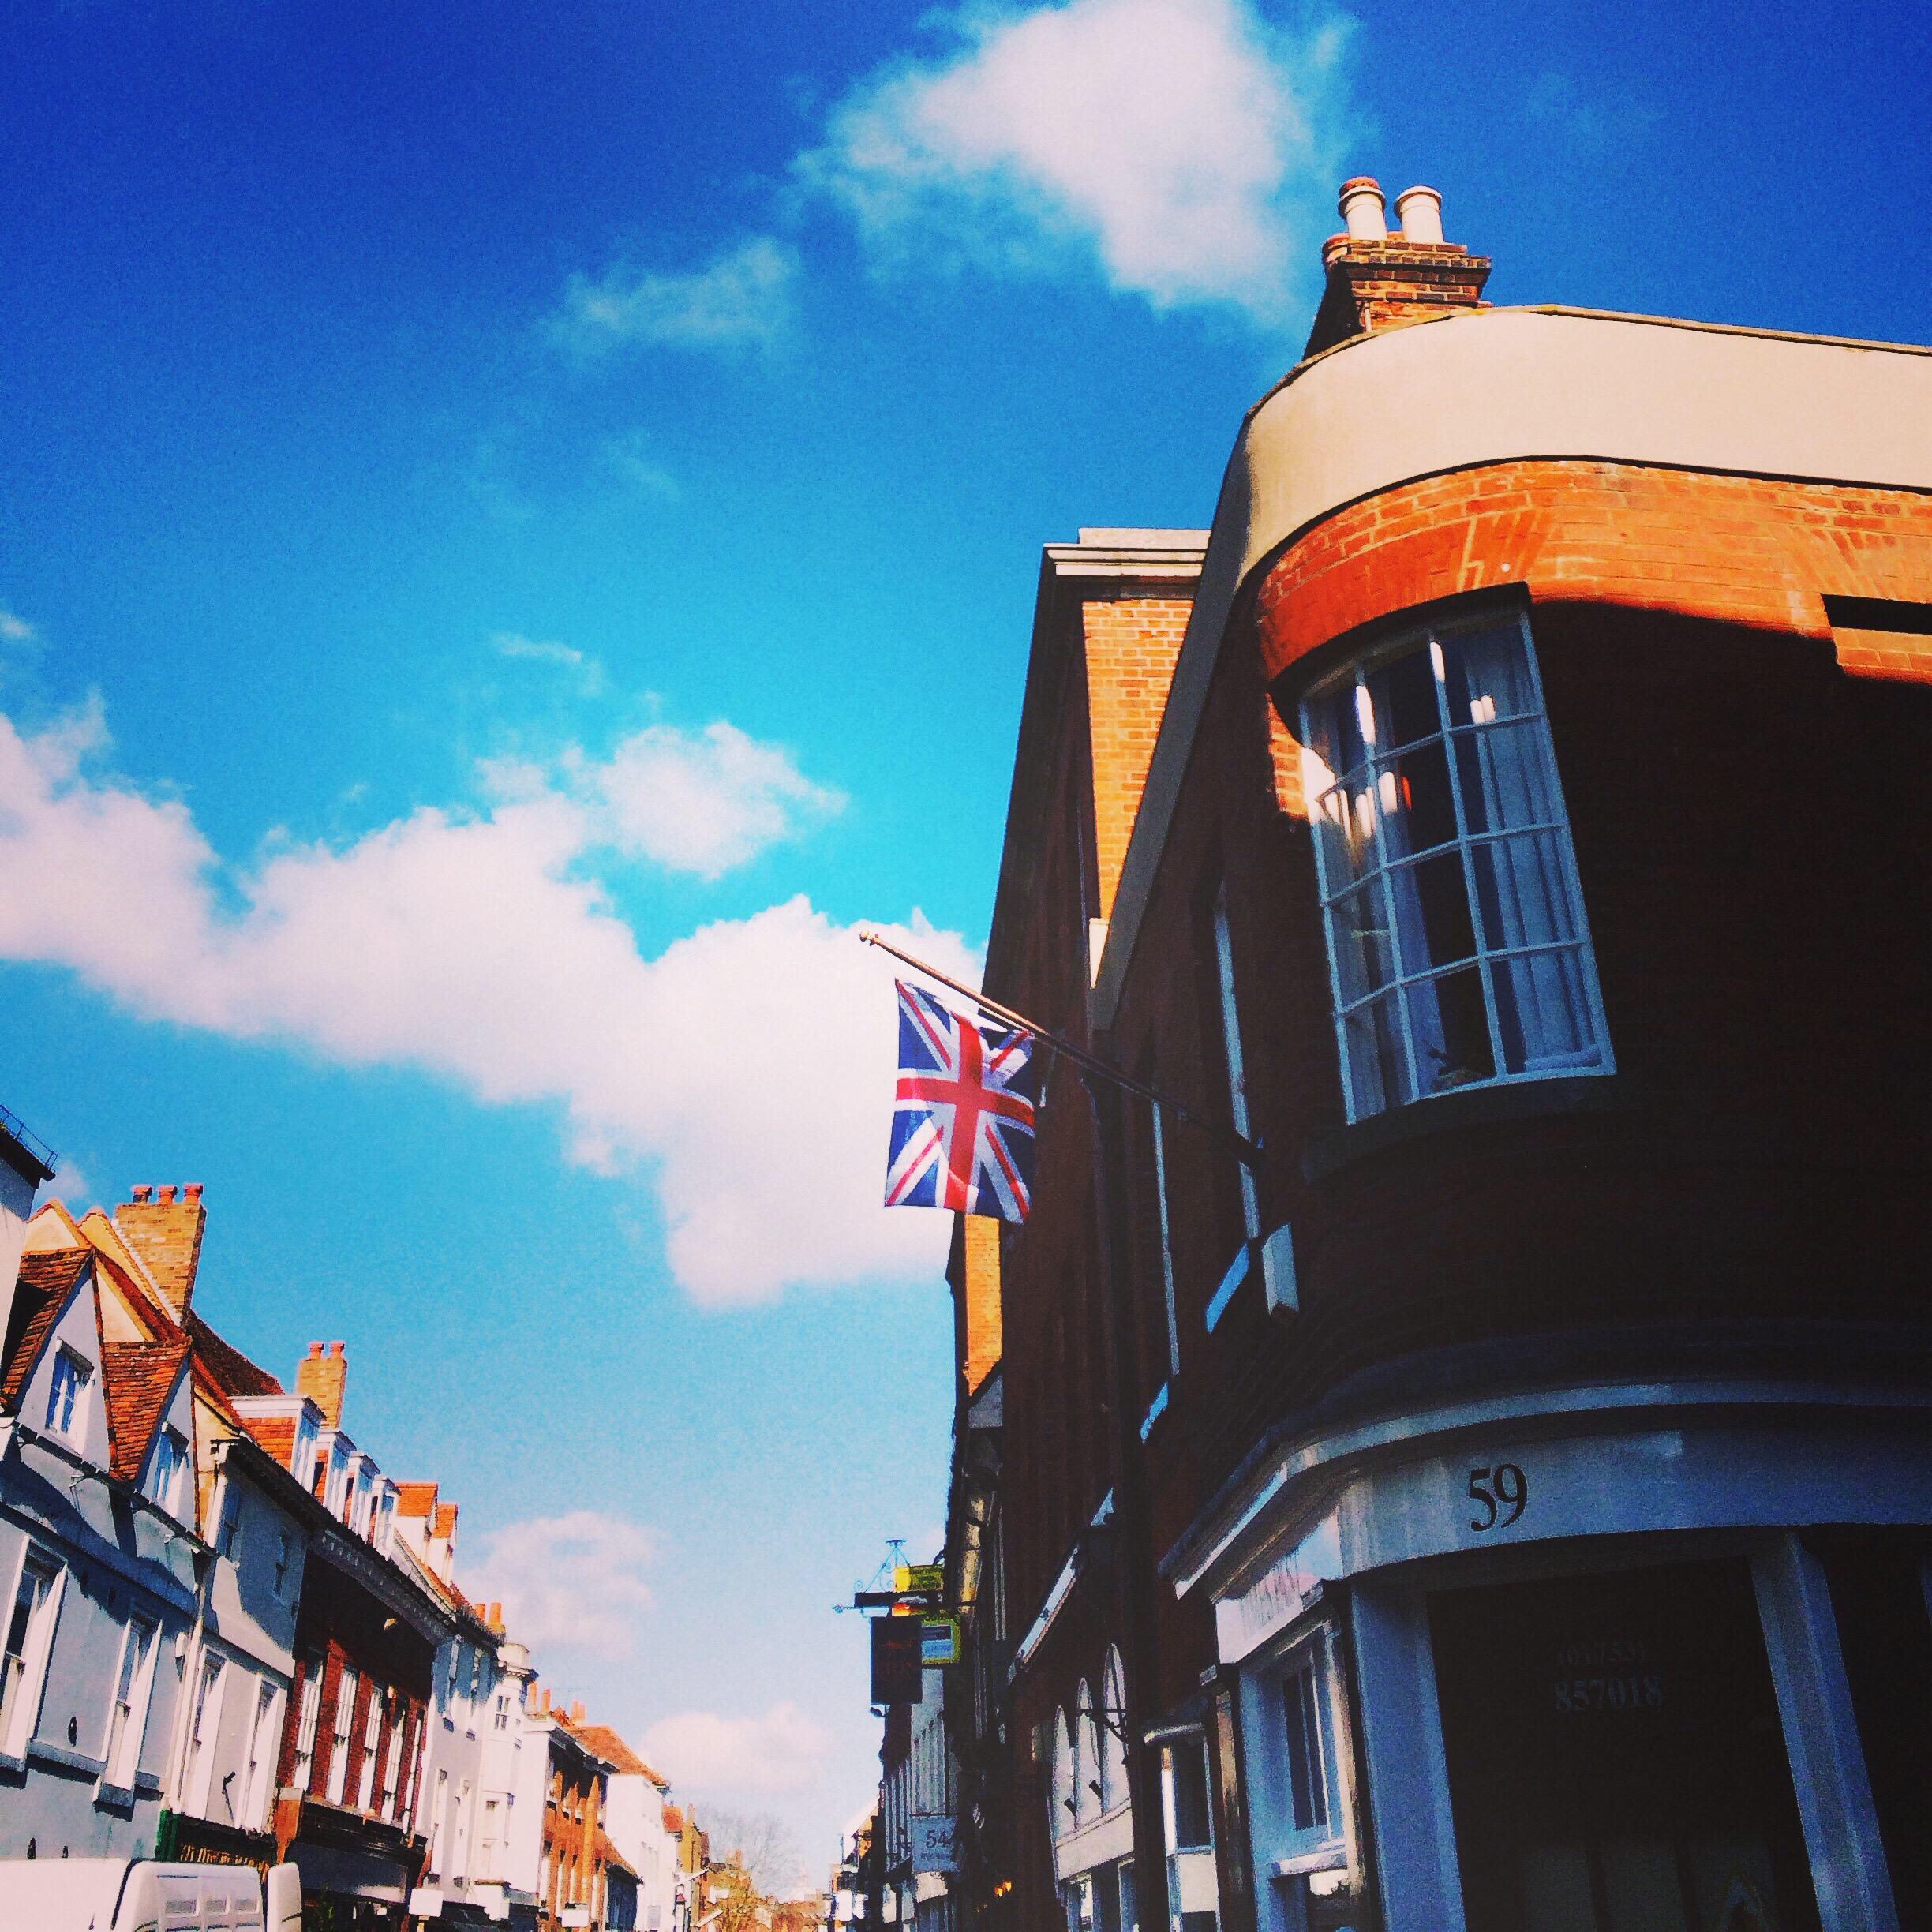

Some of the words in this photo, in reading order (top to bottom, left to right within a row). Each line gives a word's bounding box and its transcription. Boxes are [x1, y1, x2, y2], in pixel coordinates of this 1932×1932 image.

[1468, 1462, 1528, 1532] 59
[1554, 1675, 1663, 1713] 857018
[925, 1828, 951, 1848] 54
